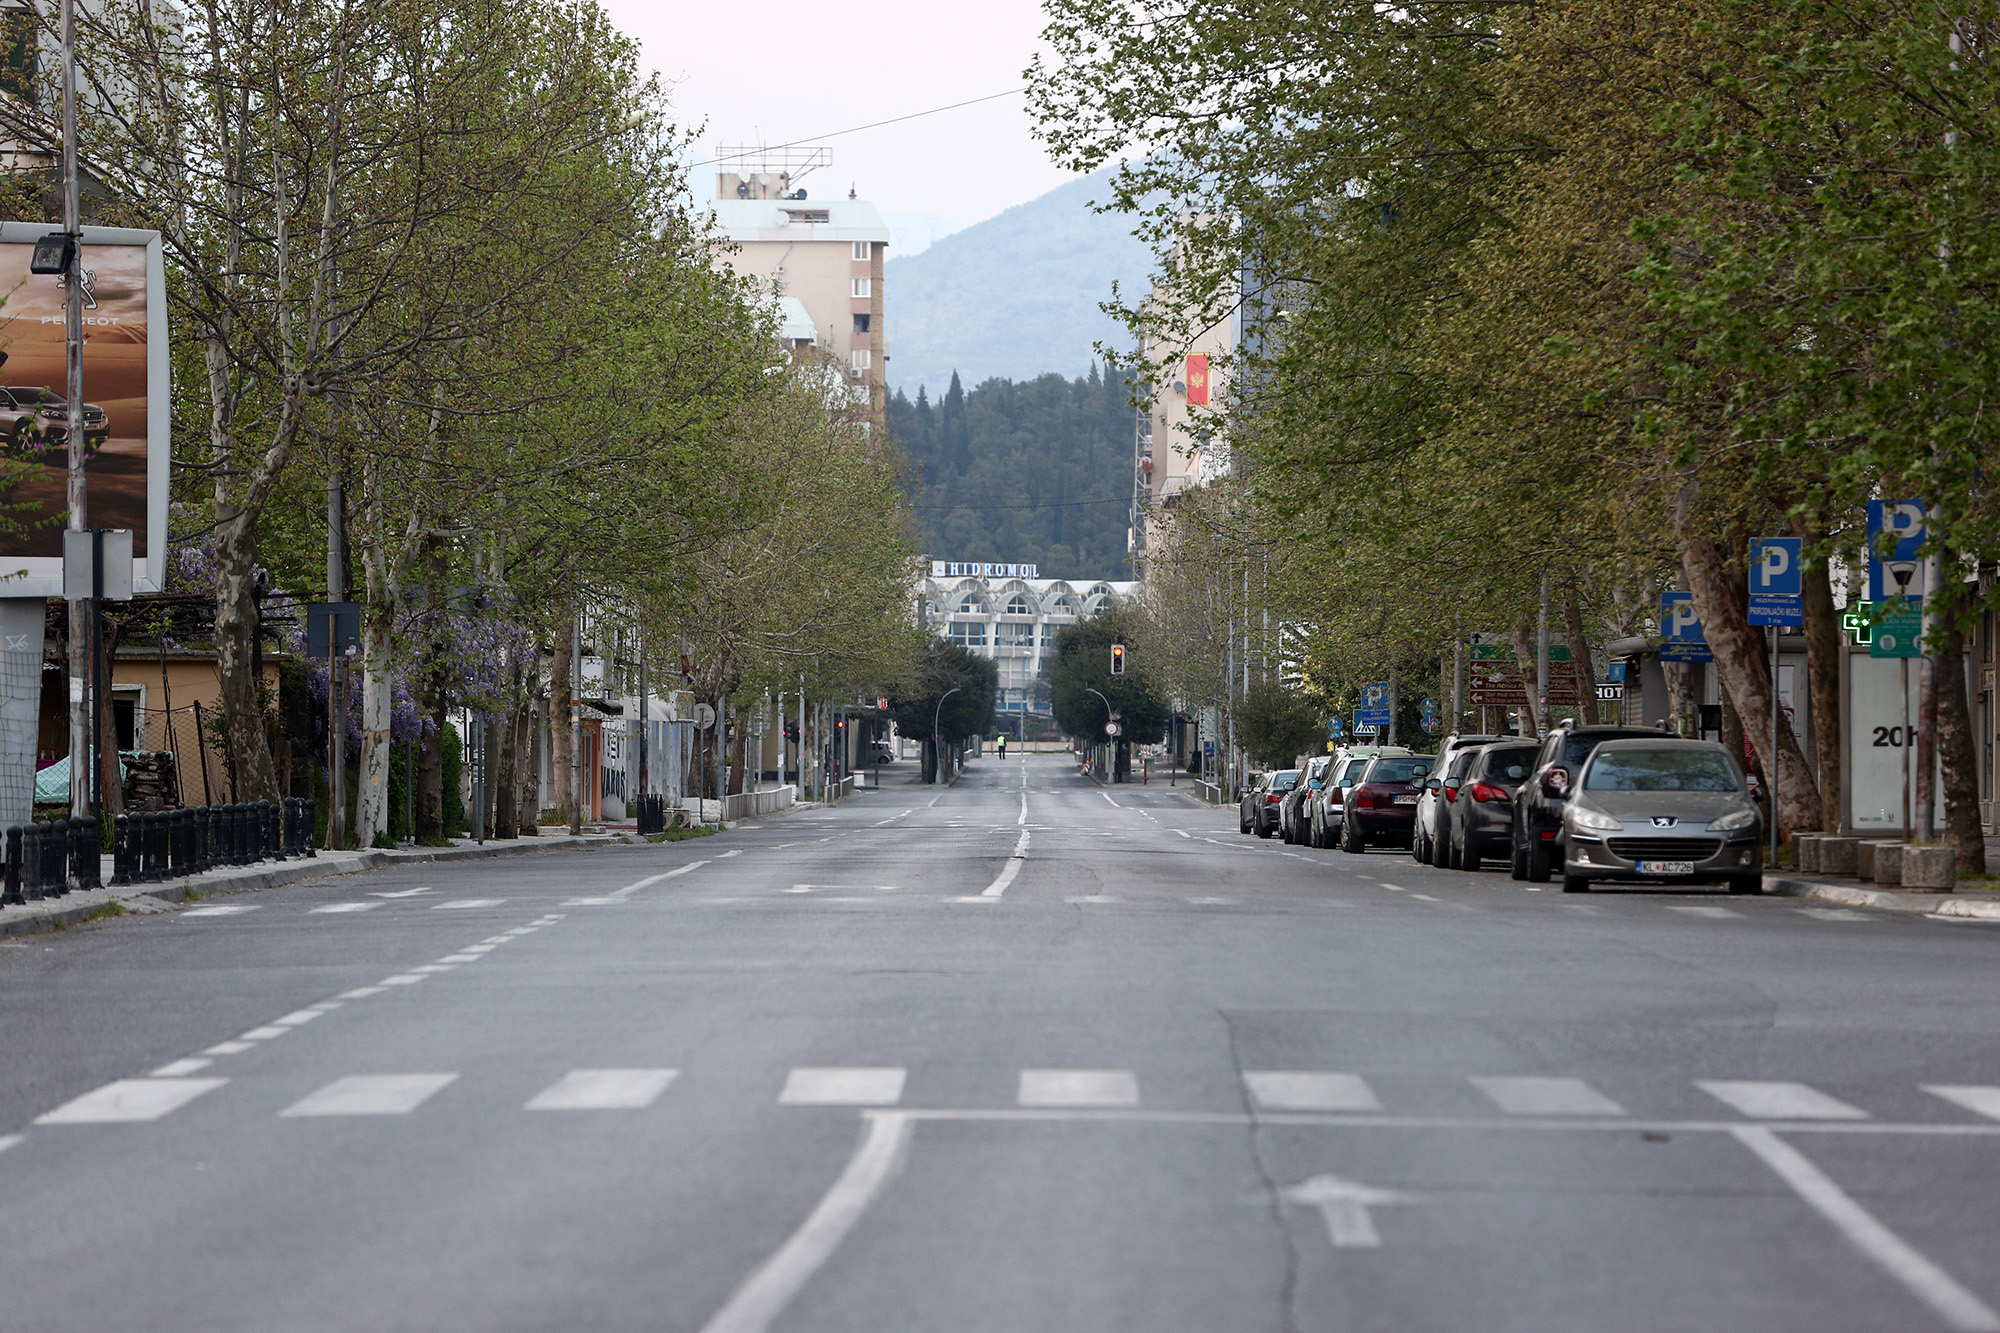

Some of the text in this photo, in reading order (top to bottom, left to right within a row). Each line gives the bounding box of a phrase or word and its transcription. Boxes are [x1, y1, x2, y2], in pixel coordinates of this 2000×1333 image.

[41, 316, 119, 326] PEEOT
[950, 562, 1040, 578] HIDROMOL
[1762, 546, 1789, 586] P
[1673, 600, 1699, 636] P
[1662, 863, 1693, 872] AC726
